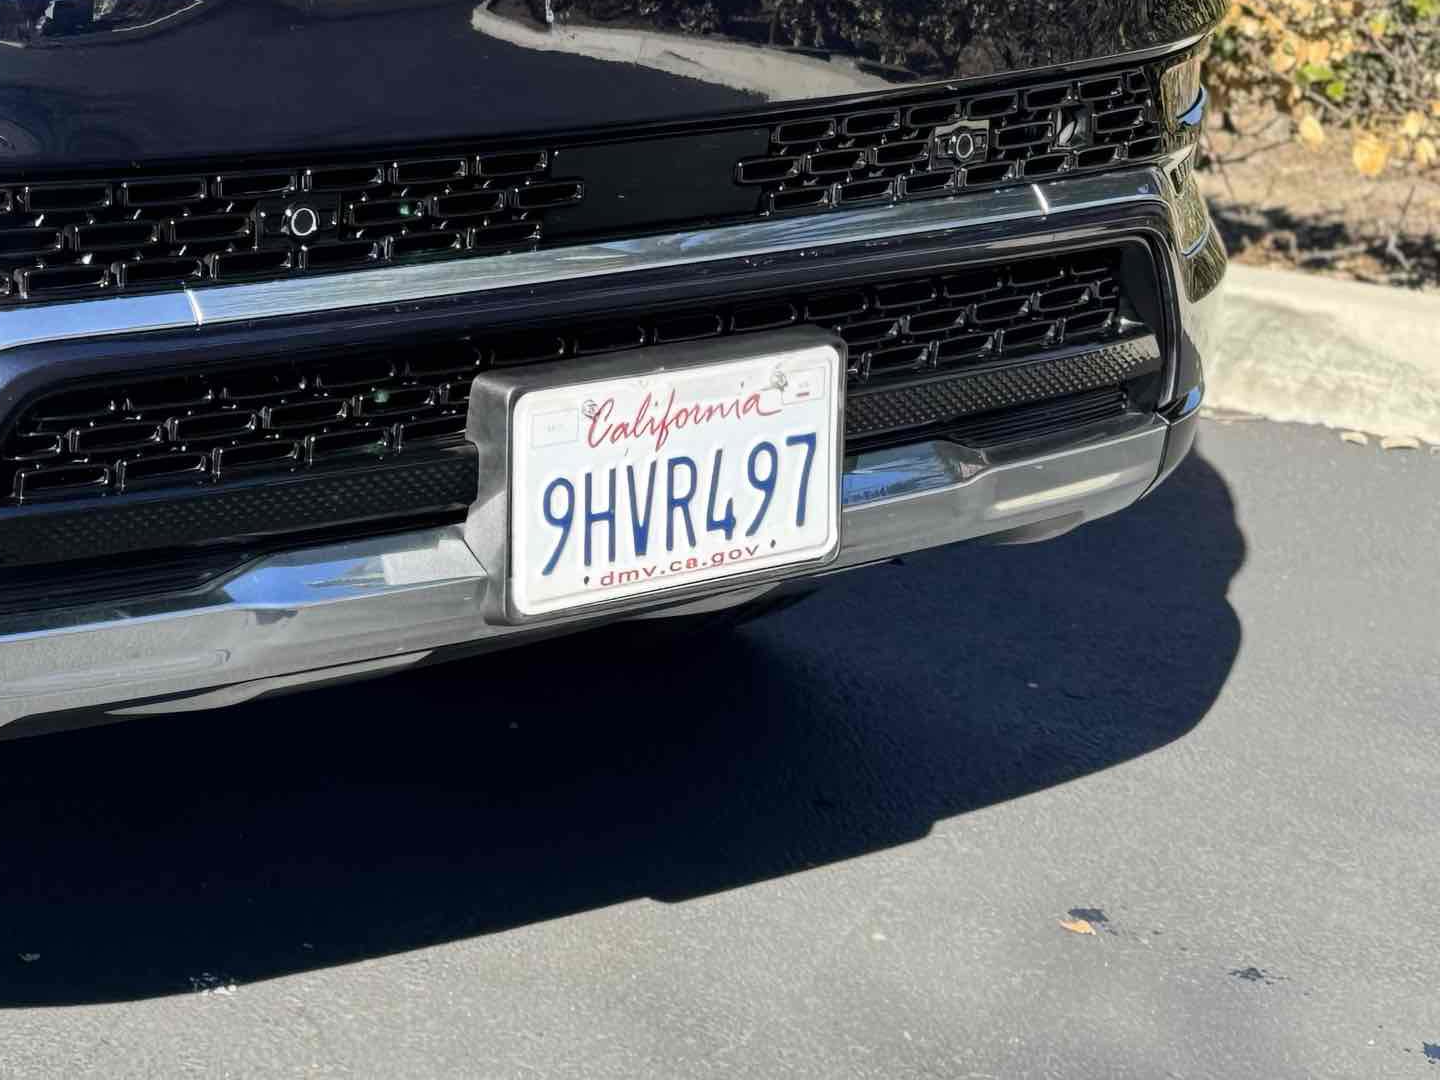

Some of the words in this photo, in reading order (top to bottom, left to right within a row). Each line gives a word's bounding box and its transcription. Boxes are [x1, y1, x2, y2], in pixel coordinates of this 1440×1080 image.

[587, 388, 782, 452] California
[541, 431, 817, 576] 9HVR497
[600, 543, 760, 588] dmv.ca.gov
